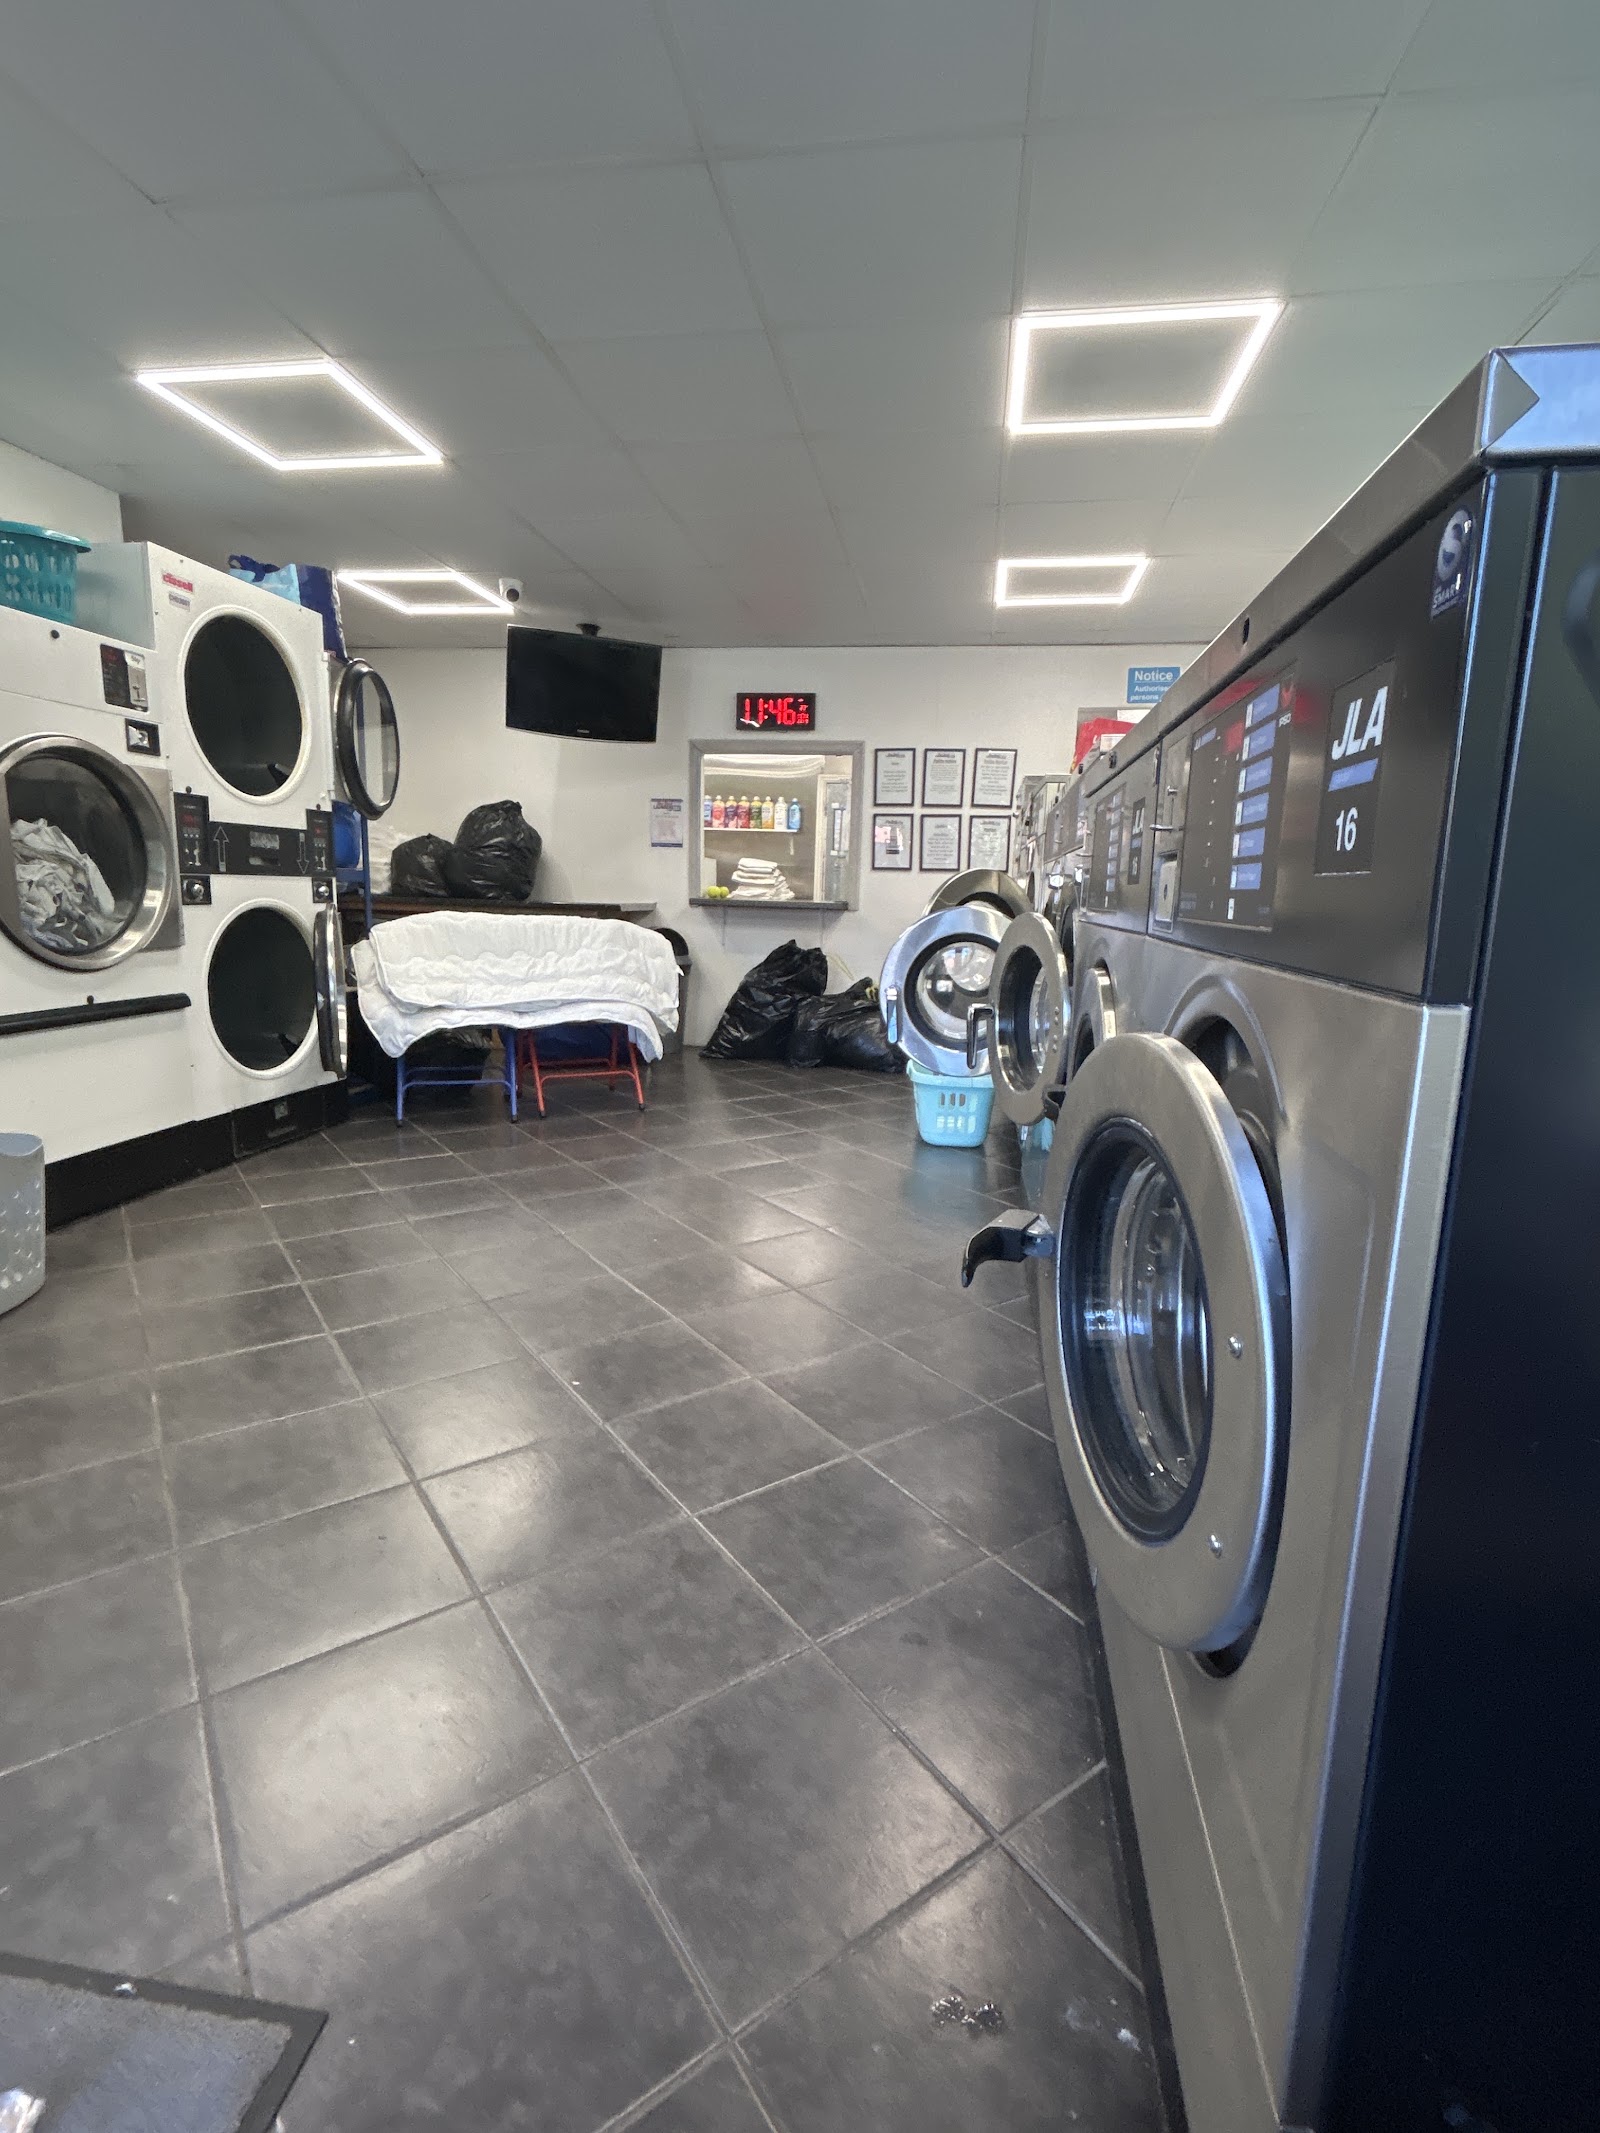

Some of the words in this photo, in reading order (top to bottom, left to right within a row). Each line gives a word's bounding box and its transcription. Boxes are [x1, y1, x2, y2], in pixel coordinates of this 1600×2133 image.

[1134, 670, 1173, 681] Notice
[1130, 694, 1159, 702] persons
[1331, 686, 1388, 761] JLA
[1335, 806, 1358, 852] 16
